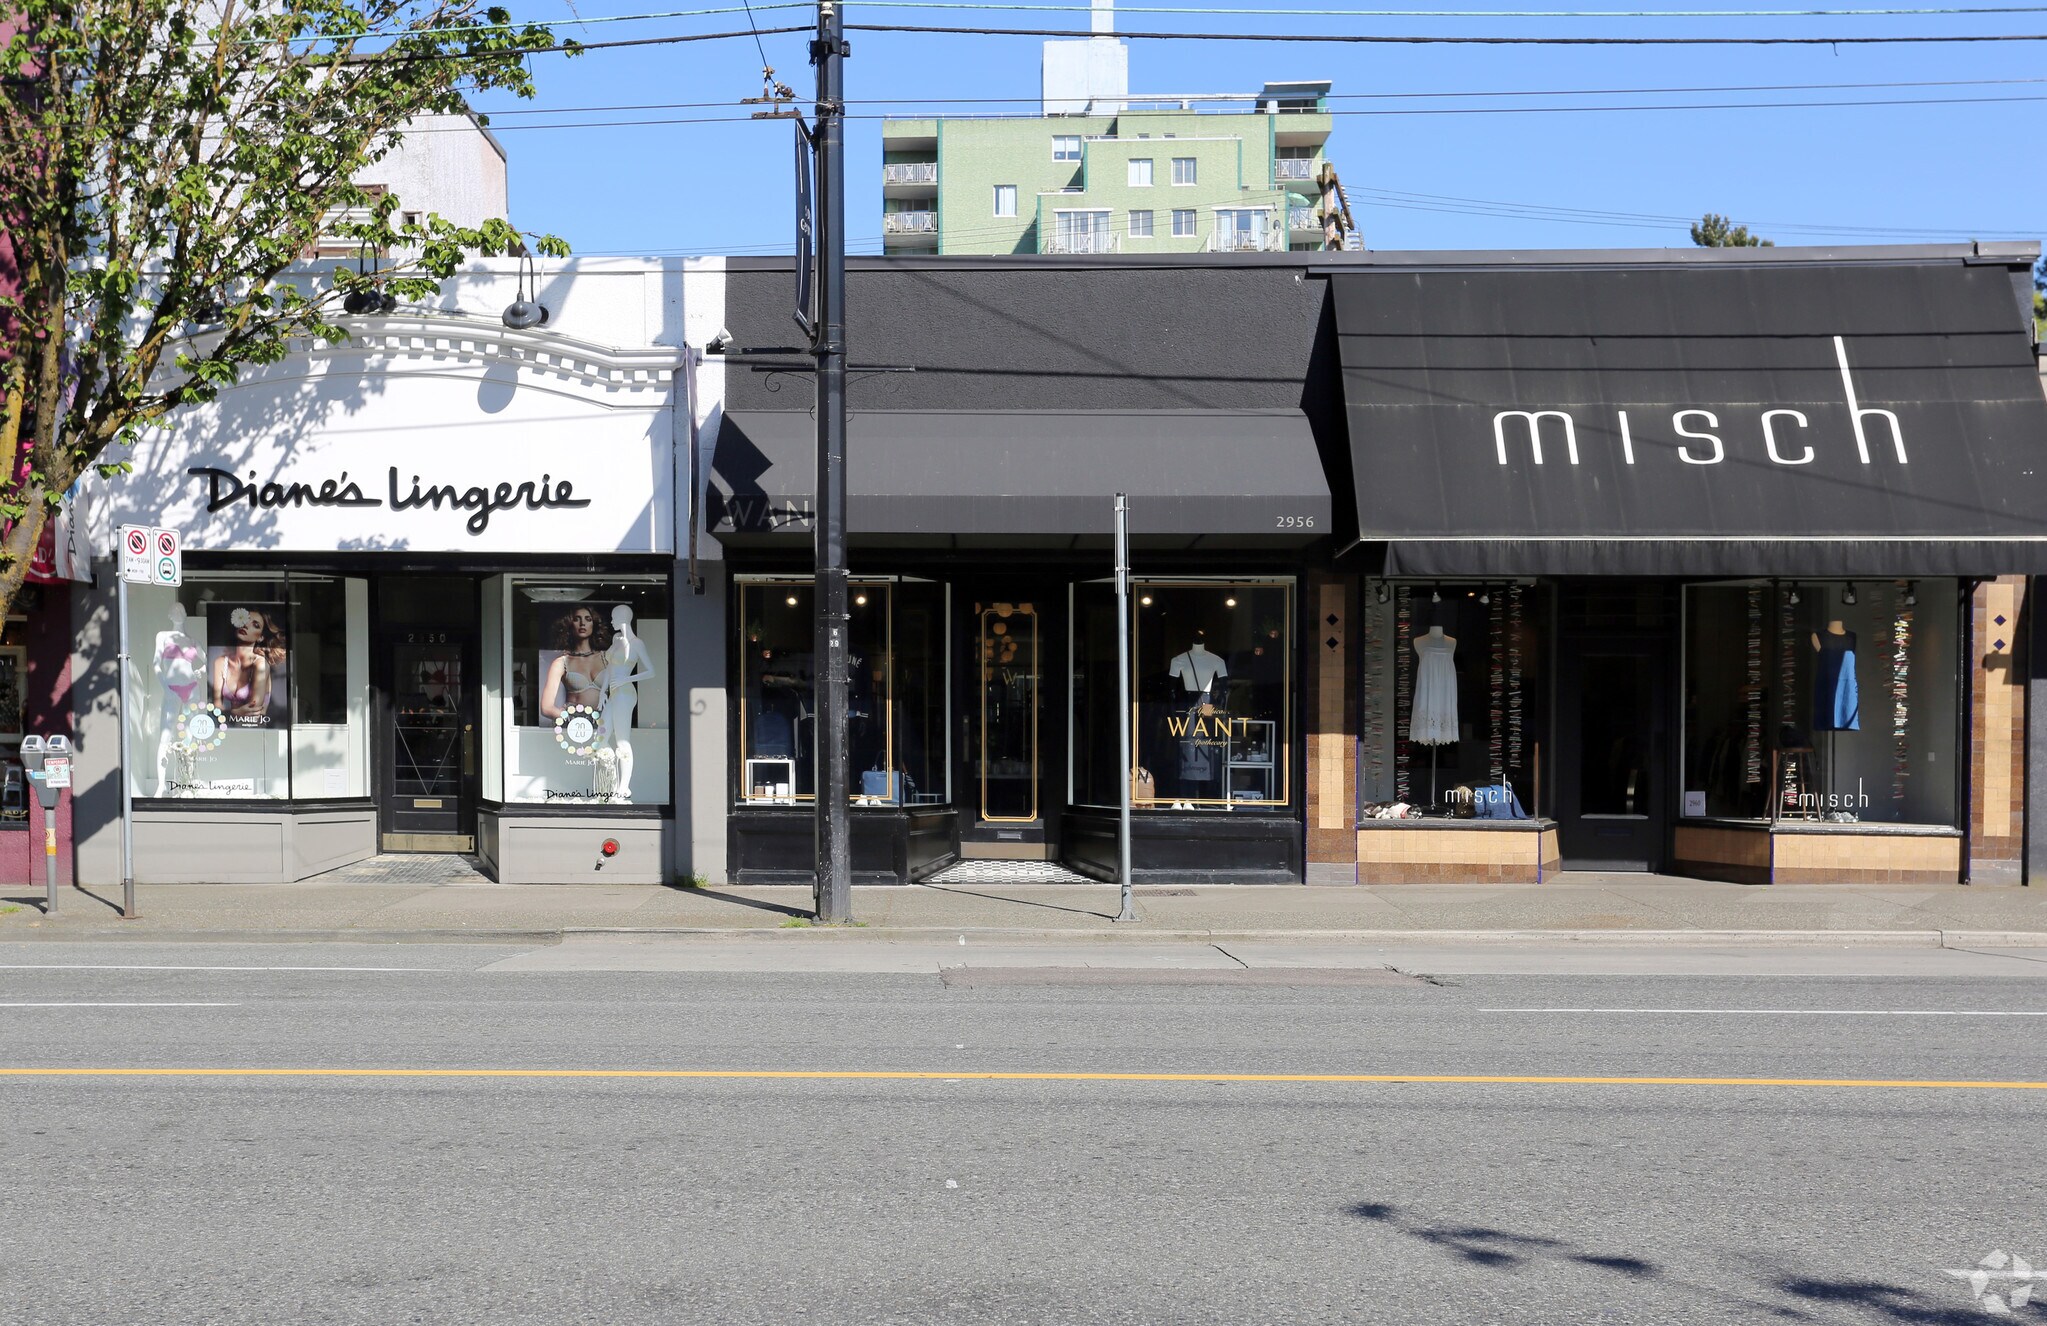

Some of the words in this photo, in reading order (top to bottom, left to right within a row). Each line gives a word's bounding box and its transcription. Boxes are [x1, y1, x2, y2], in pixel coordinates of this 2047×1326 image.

[1493, 336, 1907, 465] misch
[187, 467, 382, 513] Diane's
[724, 500, 809, 527] WAN
[1276, 516, 1314, 528] 2956
[228, 714, 259, 723] MARIE
[259, 714, 271, 725] JO
[1167, 716, 1253, 737] WANT
[543, 789, 585, 799] Diane's
[1445, 773, 1512, 803] misch
[1798, 777, 1869, 808] misch
